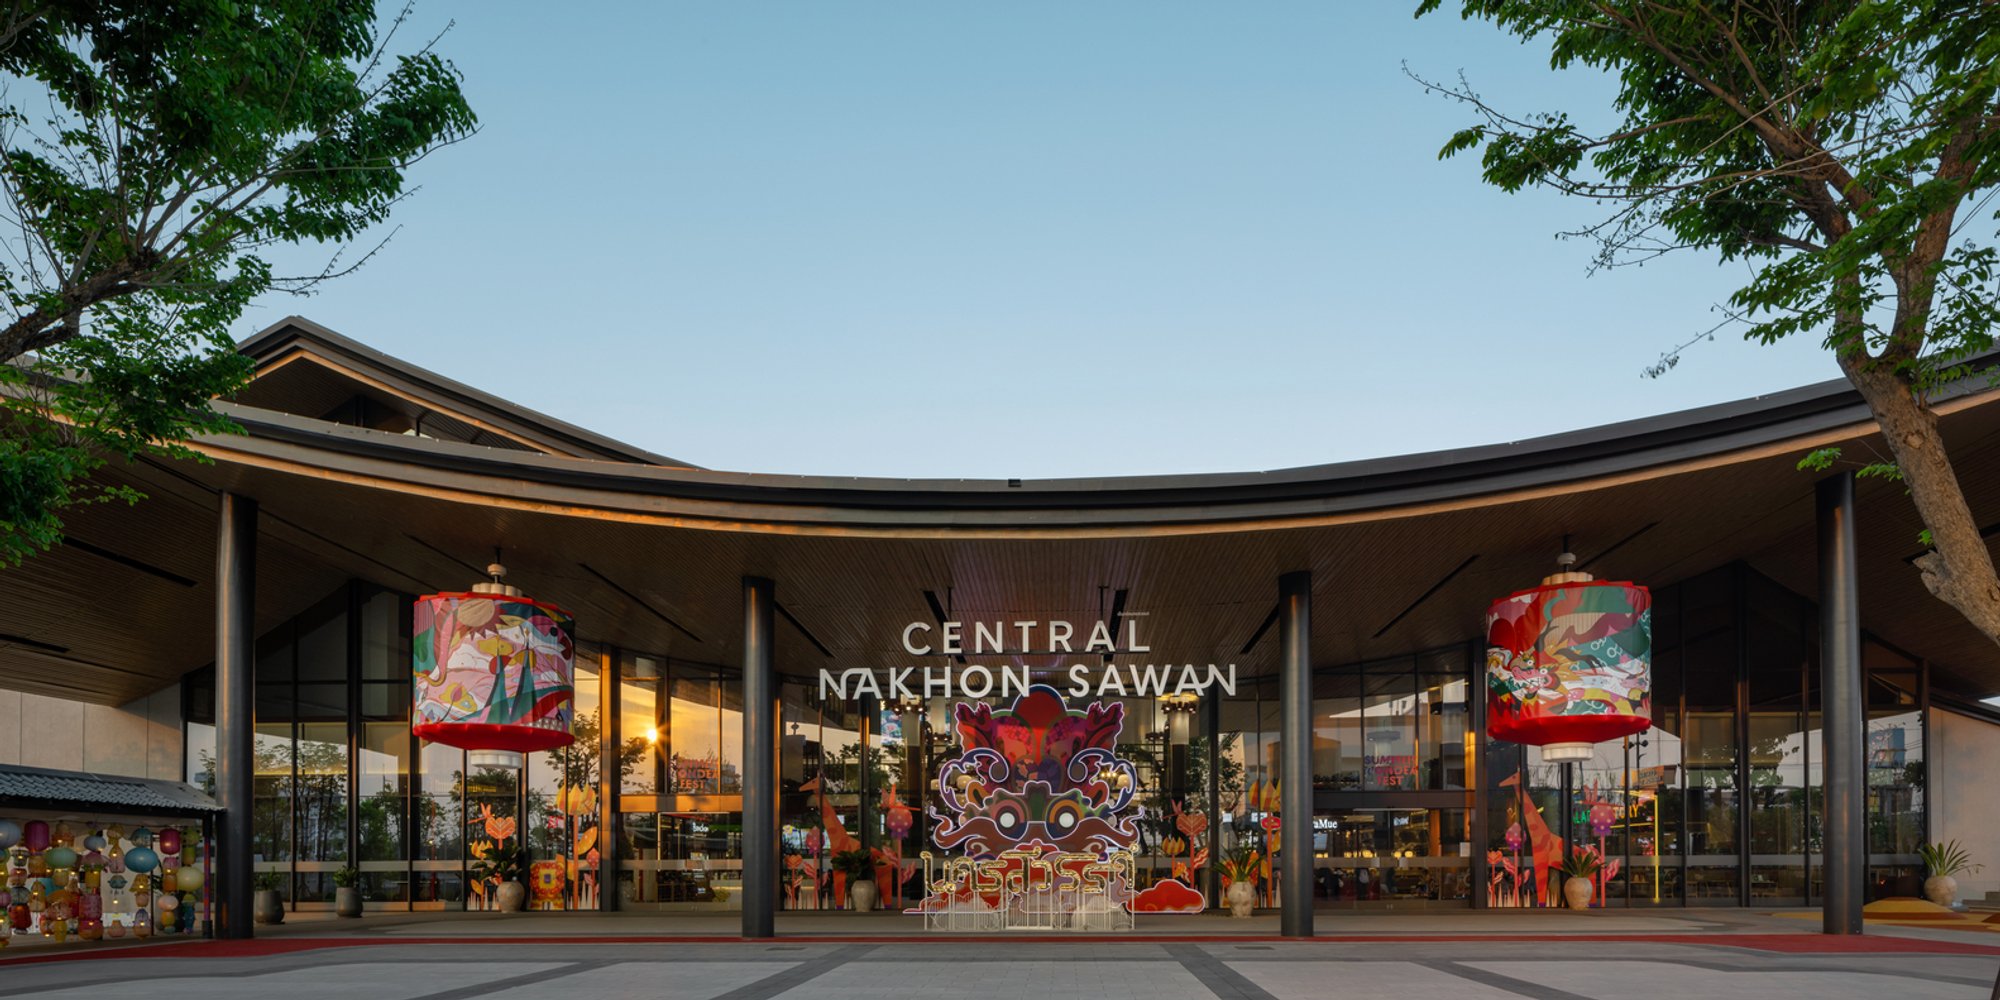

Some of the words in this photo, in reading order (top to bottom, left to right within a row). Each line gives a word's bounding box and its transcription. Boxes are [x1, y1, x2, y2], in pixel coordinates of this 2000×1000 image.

[902, 619, 1150, 655] CENTRAL
[818, 665, 1030, 700] NAKHON
[1068, 663, 1237, 698] SAWAN
[919, 843, 1139, 893] นครสวรรค์
